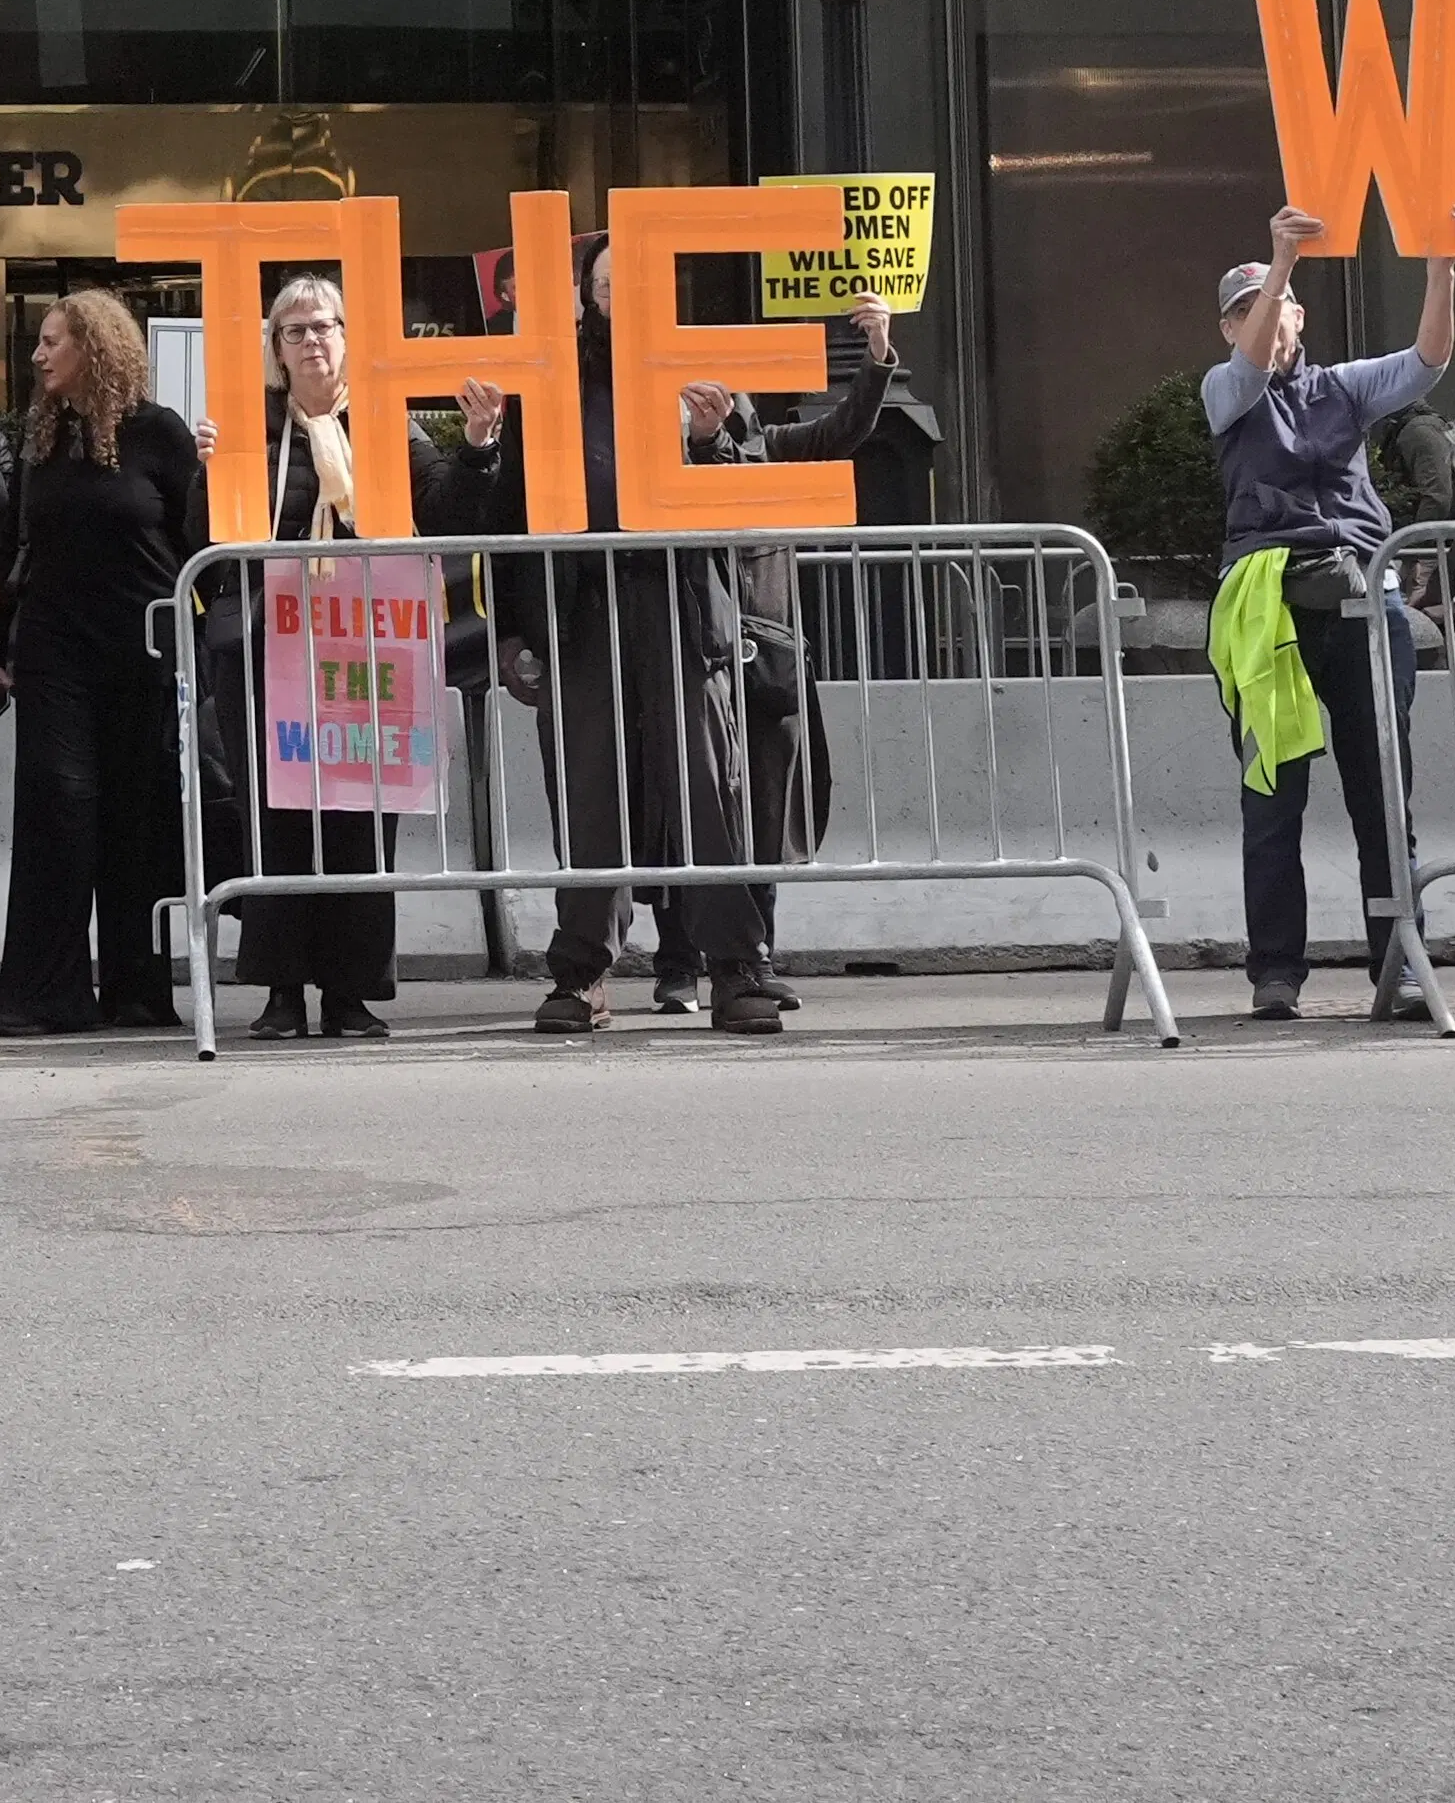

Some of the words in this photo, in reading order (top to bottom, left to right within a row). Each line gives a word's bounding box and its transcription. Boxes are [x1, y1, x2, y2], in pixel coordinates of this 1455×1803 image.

[889, 186, 931, 210] OFF
[789, 249, 860, 272] WILL
[867, 247, 916, 269] SAVE
[765, 276, 821, 300] THE
[829, 273, 925, 298] COUNTRY
[115, 185, 858, 544] THE
[319, 660, 395, 702] THE
[275, 720, 434, 766] WOMEN
